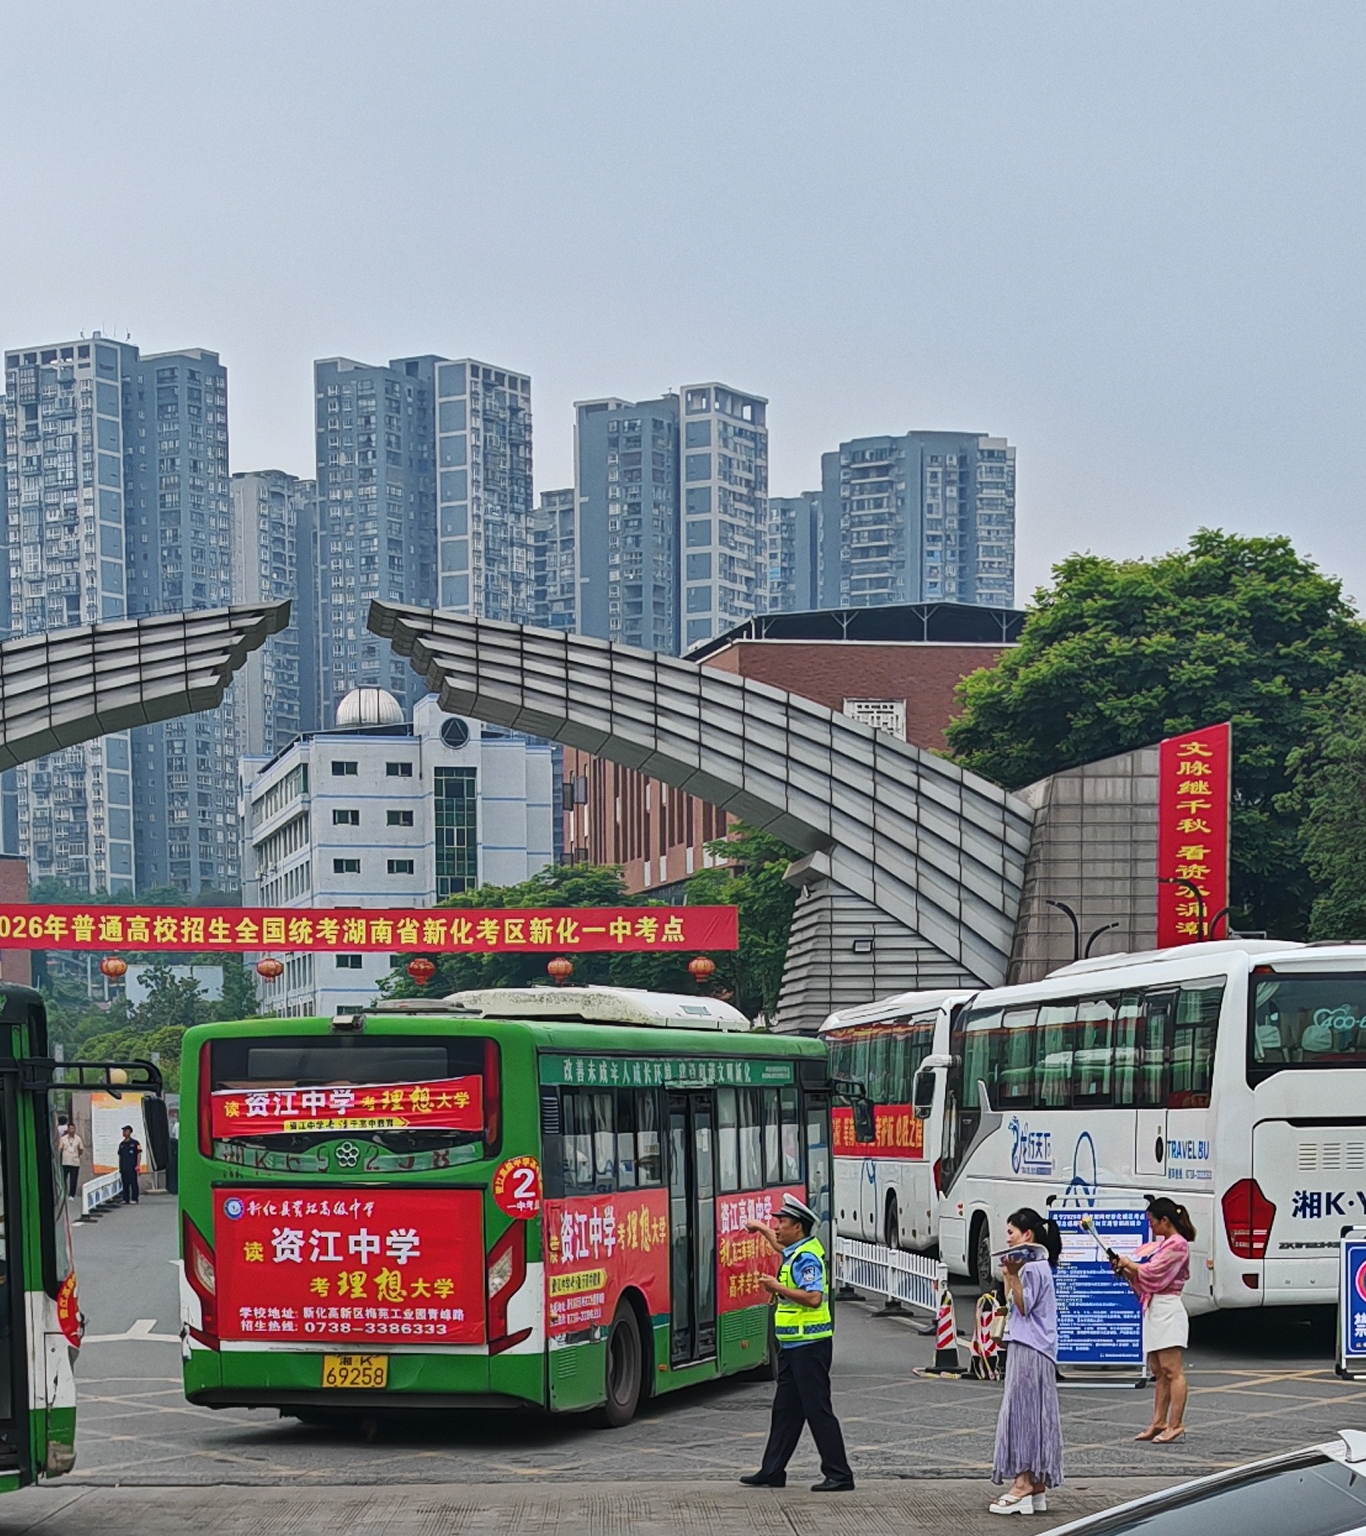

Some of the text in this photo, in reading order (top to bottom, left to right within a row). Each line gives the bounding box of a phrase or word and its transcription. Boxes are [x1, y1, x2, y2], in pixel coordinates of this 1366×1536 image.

[1176, 742, 1213, 833] 文脉继千秋
[1167, 1140, 1196, 1160] TRAVEL
[513, 1168, 536, 1198] 2
[243, 1227, 421, 1265] 读资江中学
[310, 1267, 455, 1303] 考理想大学
[326, 1367, 385, 1386] 69258
